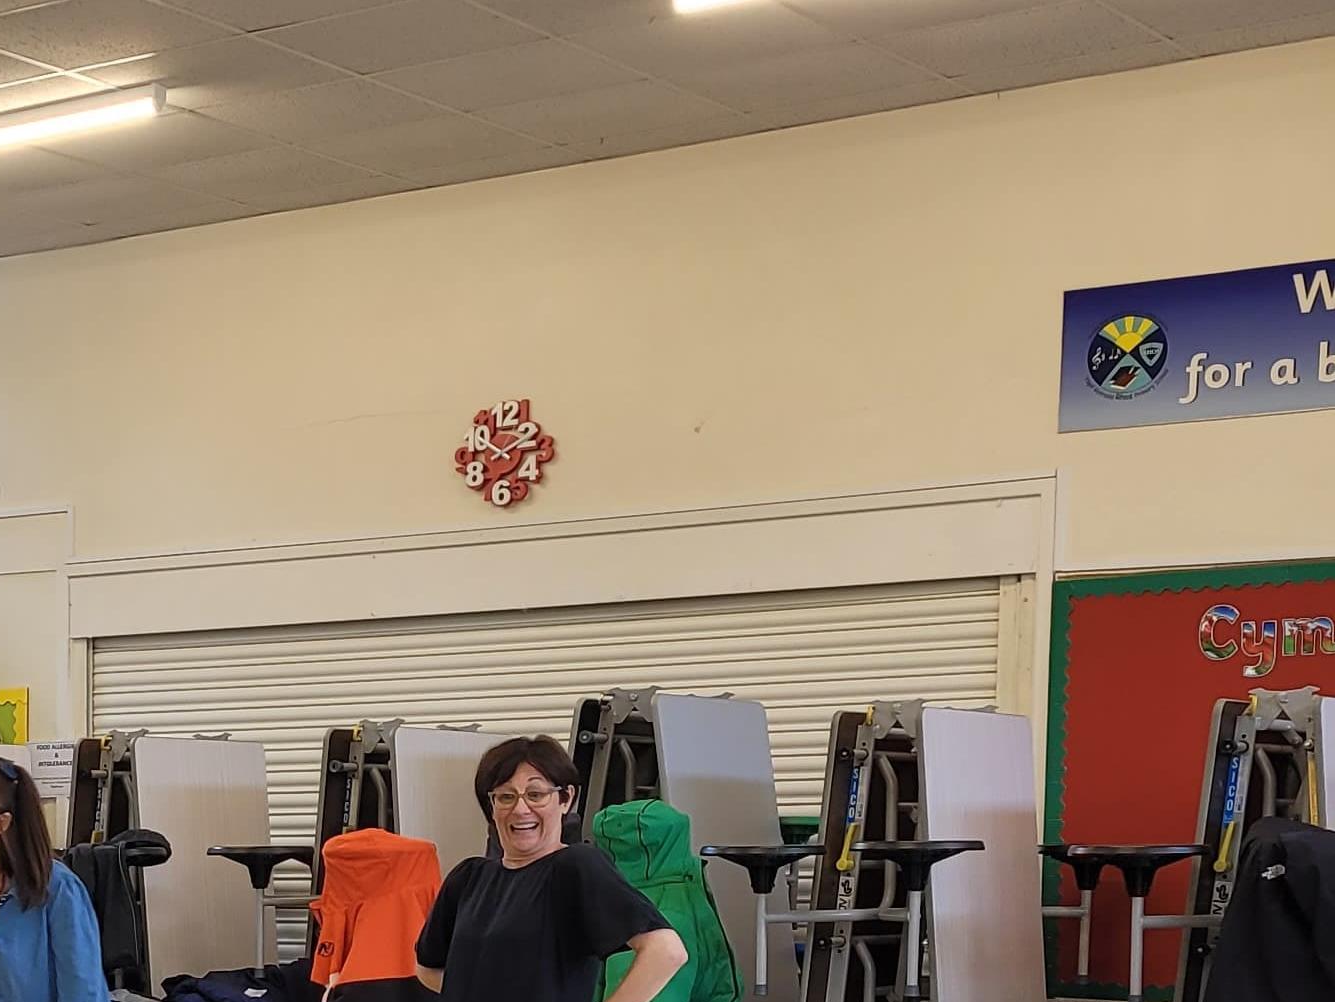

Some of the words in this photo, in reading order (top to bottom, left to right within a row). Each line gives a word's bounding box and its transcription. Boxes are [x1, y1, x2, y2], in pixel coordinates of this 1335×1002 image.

[1178, 352, 1253, 404] for
[1269, 357, 1299, 386] a
[491, 400, 520, 429] 12
[464, 424, 491, 452] 10
[517, 421, 540, 450] 2
[465, 461, 484, 488] 8
[517, 455, 539, 480] 4
[491, 480, 511, 506] 6
[1198, 604, 1335, 677] Cym
[848, 768, 859, 818] SICO
[1226, 756, 1239, 812] SICO
[343, 778, 352, 824] SICO
